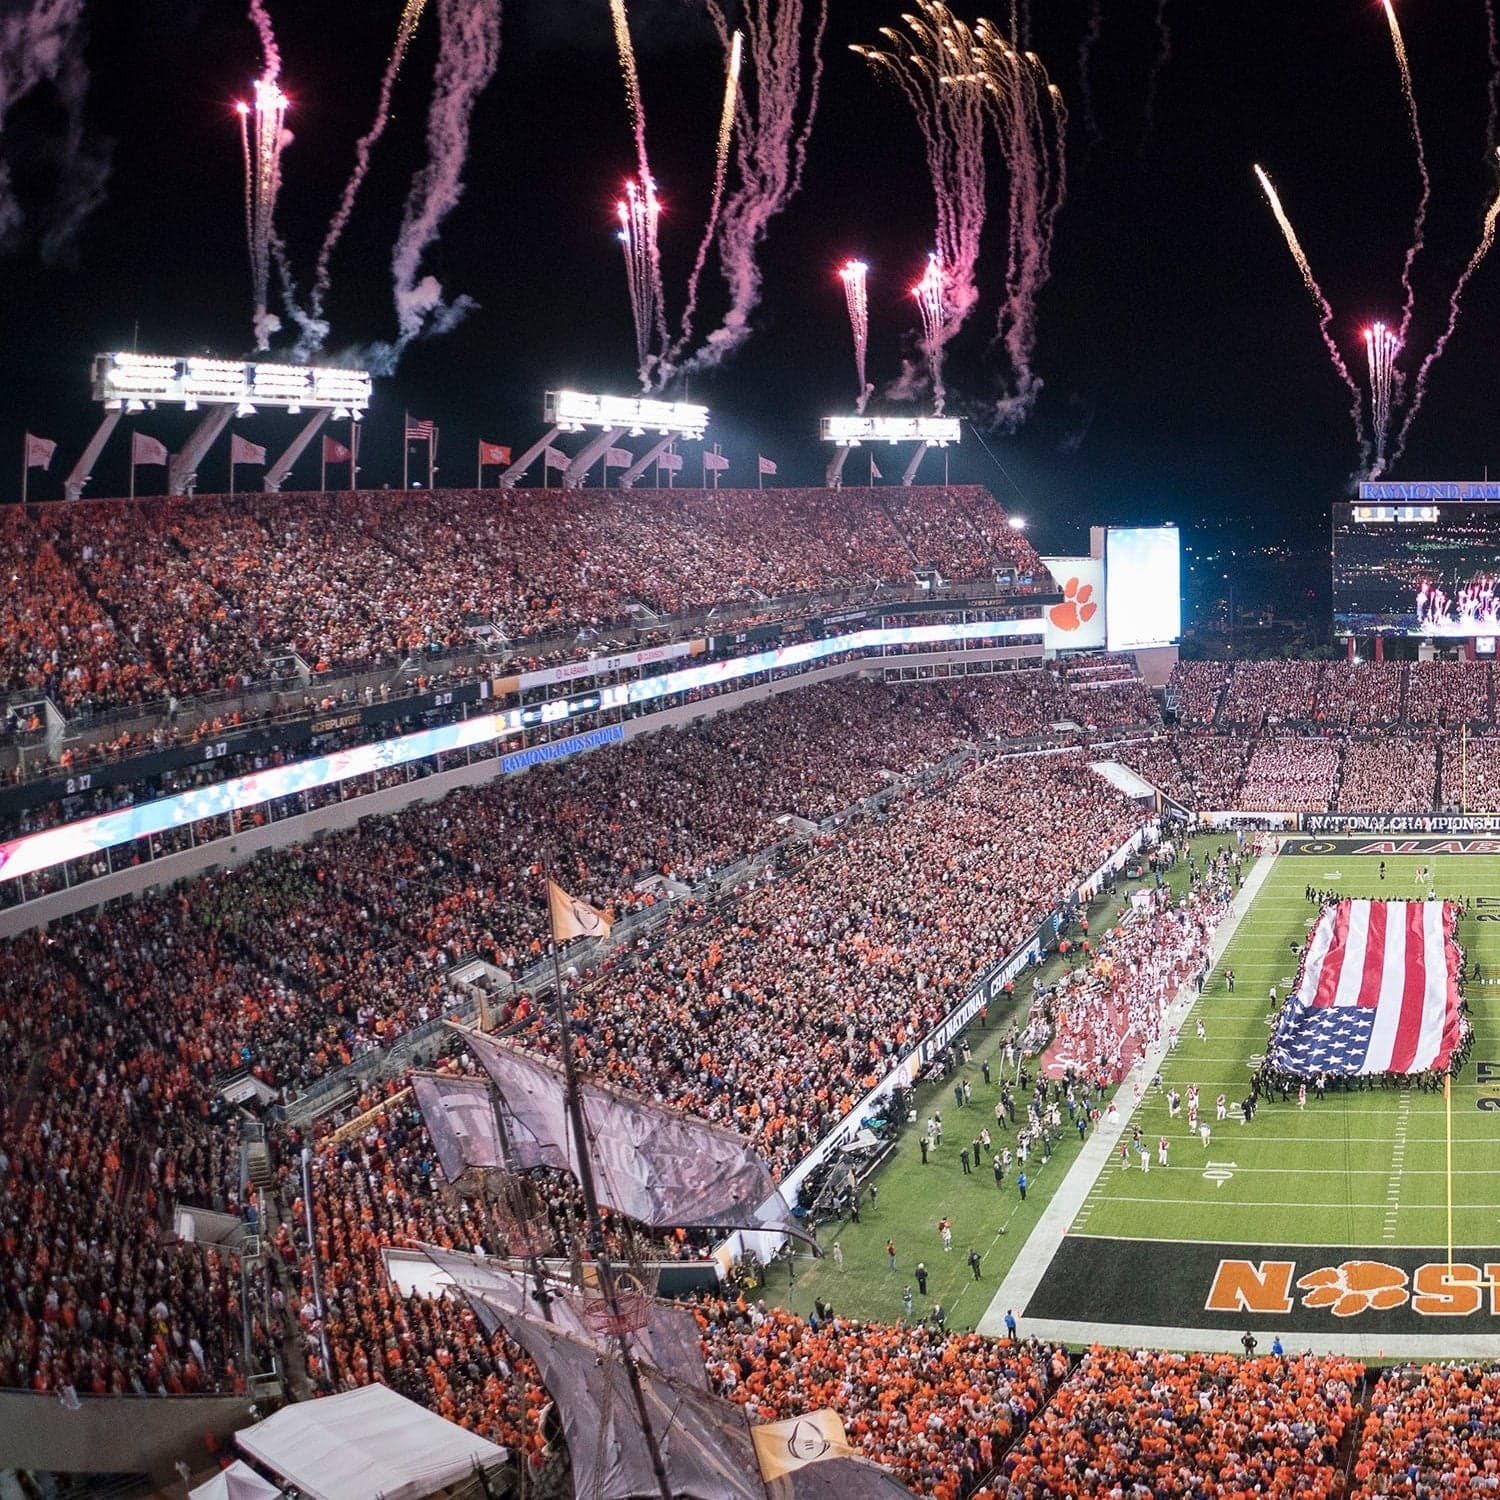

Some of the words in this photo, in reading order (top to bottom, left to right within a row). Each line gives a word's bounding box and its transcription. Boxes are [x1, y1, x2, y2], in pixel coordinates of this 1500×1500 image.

[1363, 484, 1460, 499] RAYMOND
[502, 741, 553, 774] RAYMOND
[552, 735, 585, 759] JAMES
[584, 724, 625, 748] STADIUM
[1309, 815, 1388, 830] NATIONAL
[949, 989, 987, 1043] NATIONAL
[1202, 1160, 1237, 1180] 10
